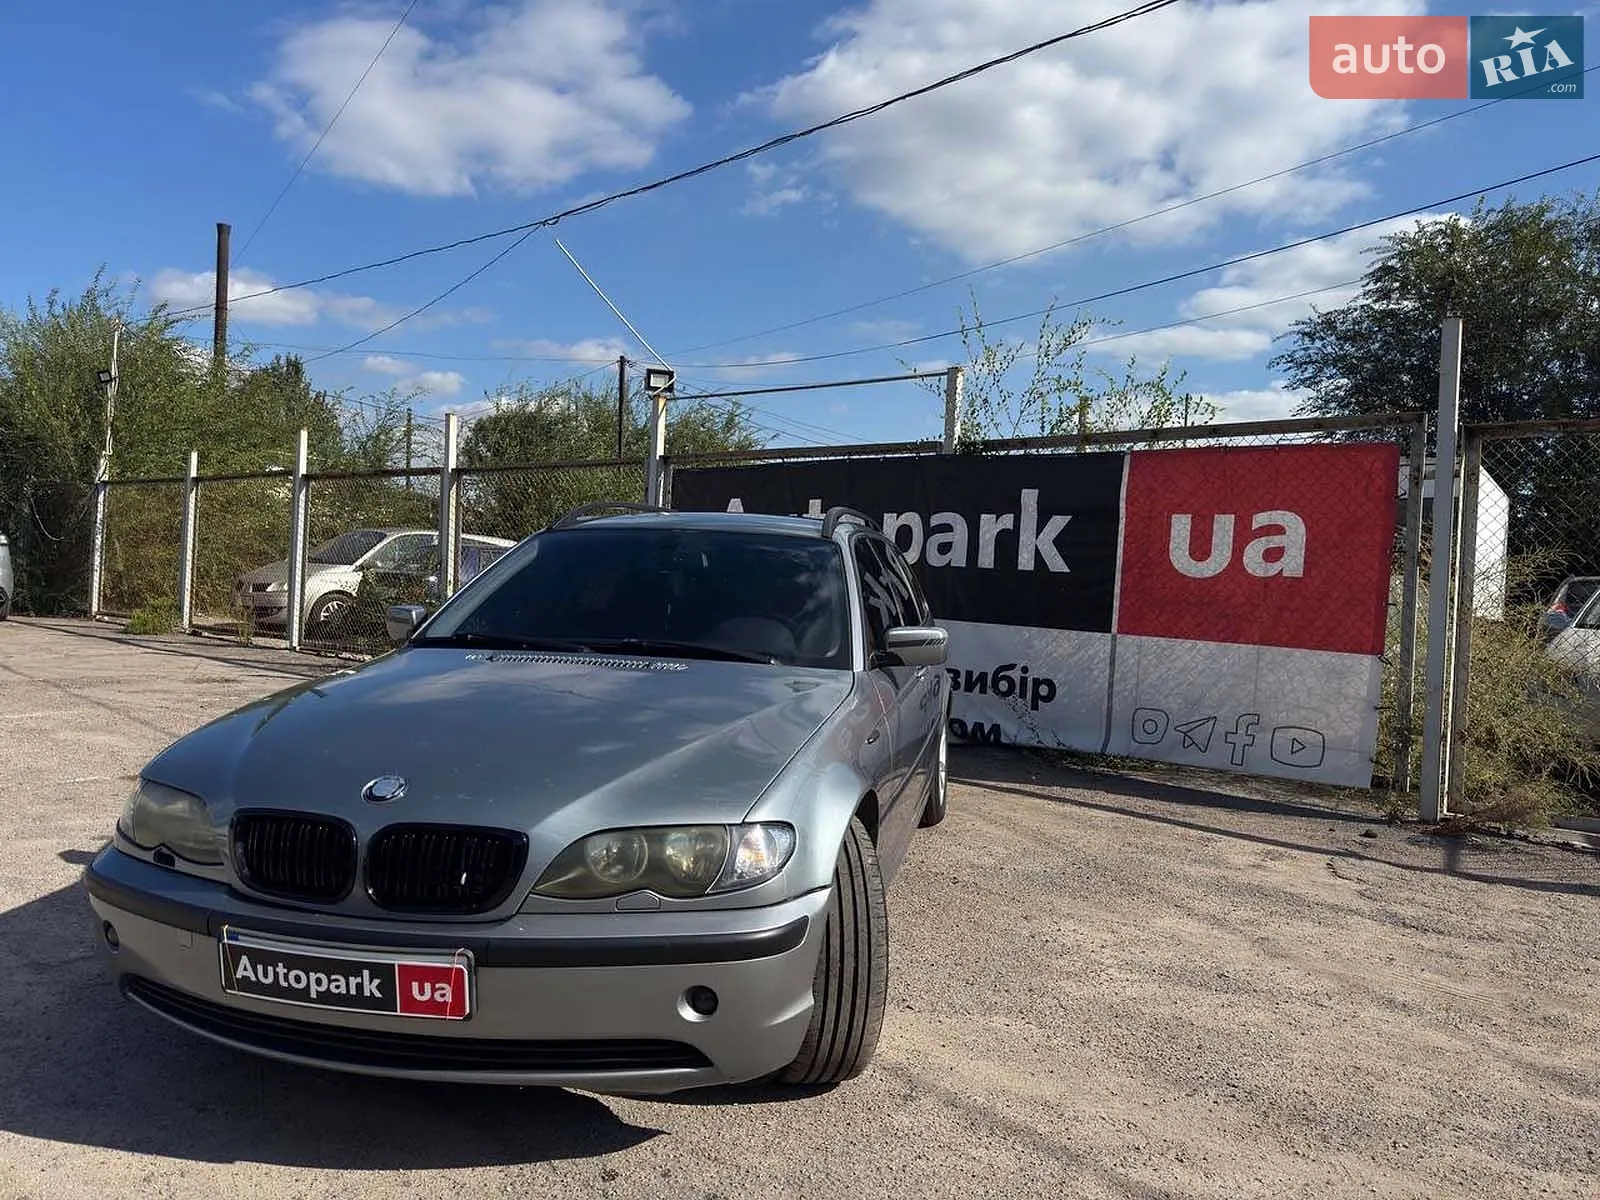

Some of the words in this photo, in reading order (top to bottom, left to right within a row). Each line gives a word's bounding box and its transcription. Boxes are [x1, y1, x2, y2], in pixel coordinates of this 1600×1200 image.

[726, 488, 1072, 573] park
[1169, 508, 1307, 578] ua
[235, 954, 383, 999] Autopark
[411, 980, 453, 1003] ua
